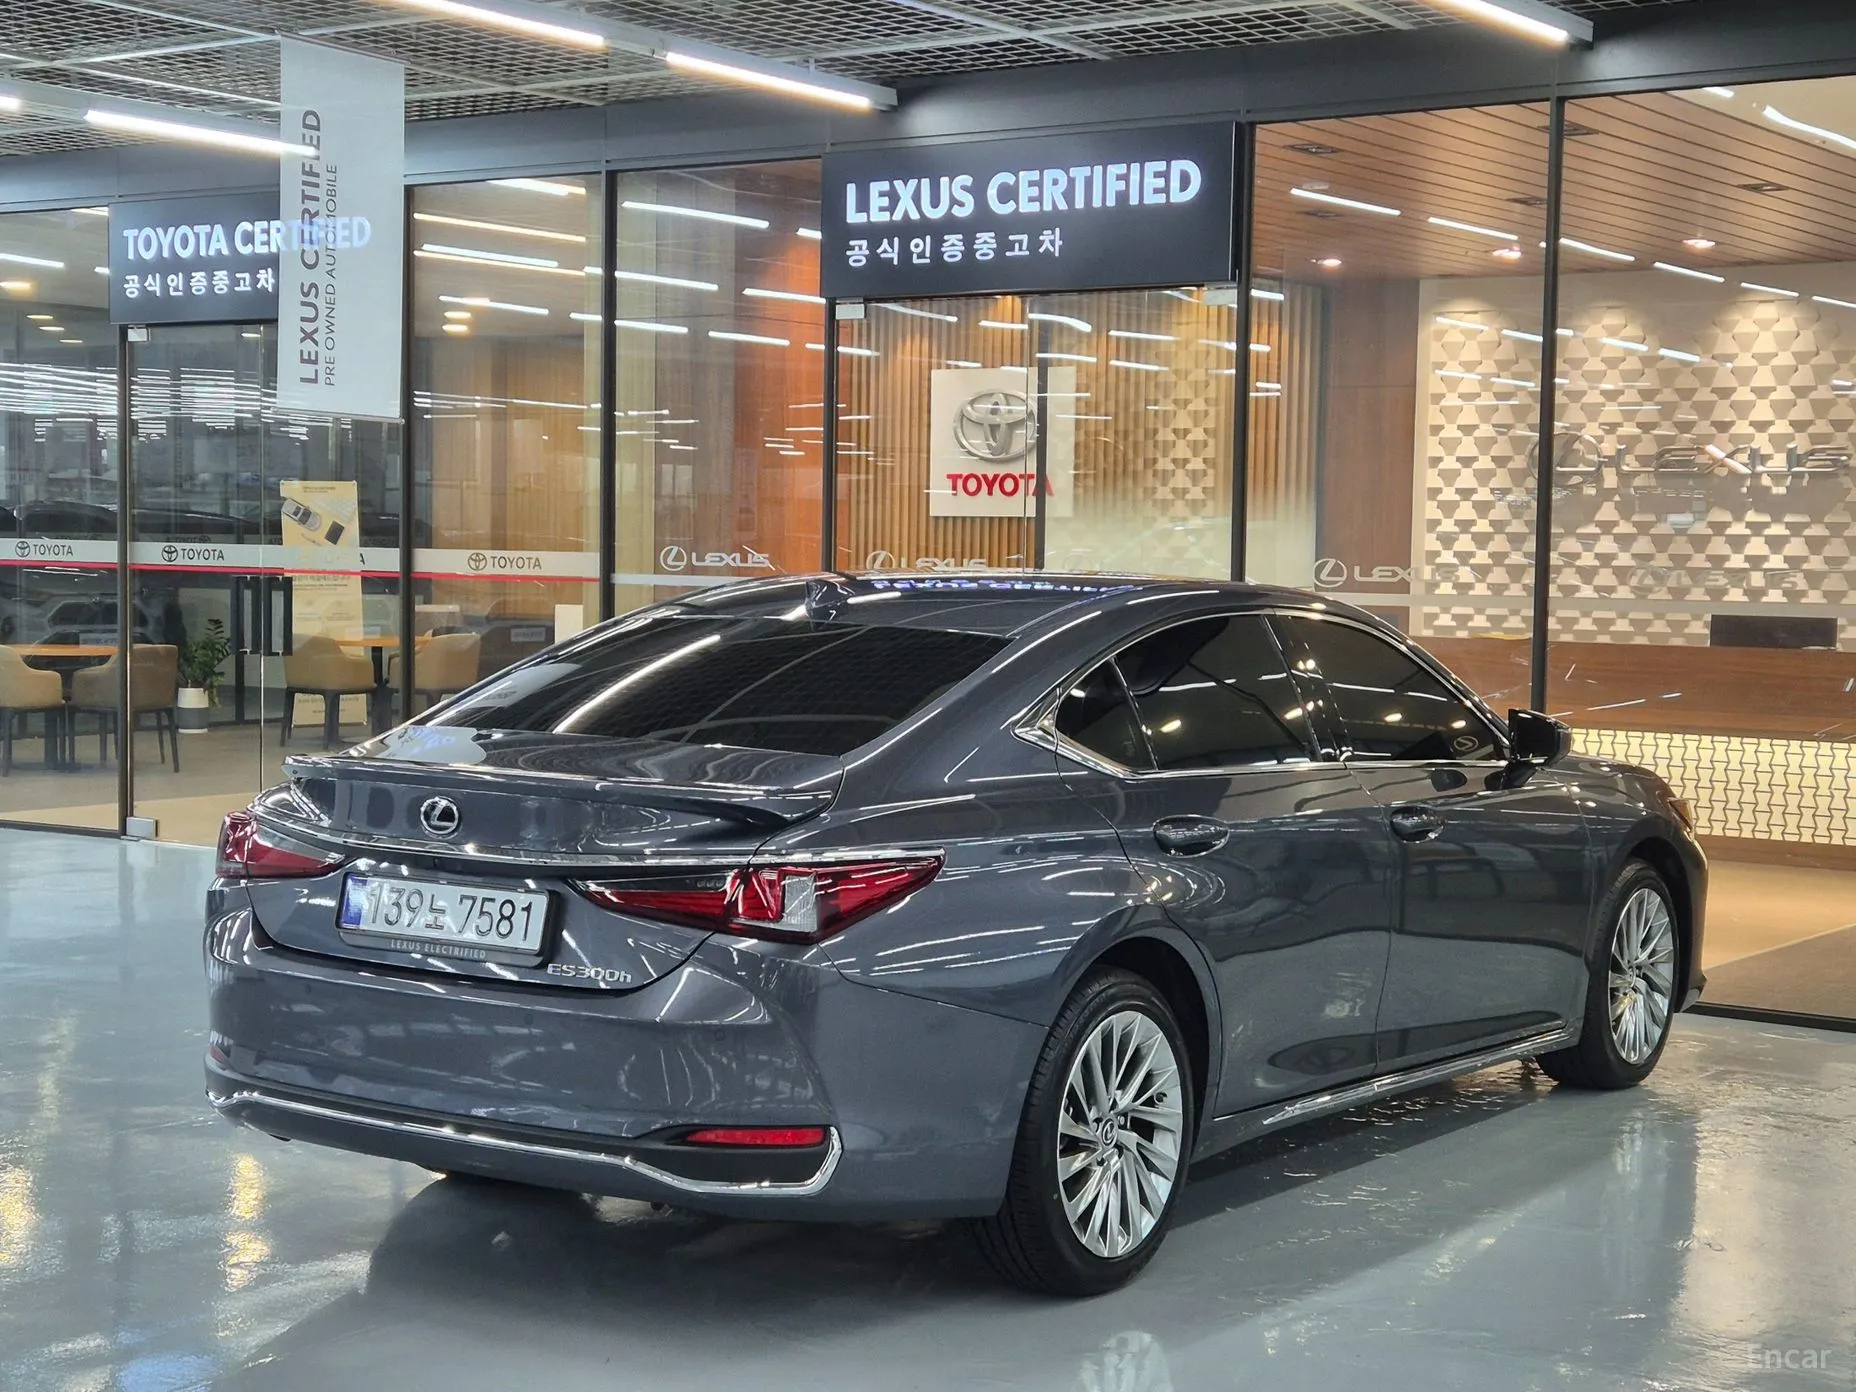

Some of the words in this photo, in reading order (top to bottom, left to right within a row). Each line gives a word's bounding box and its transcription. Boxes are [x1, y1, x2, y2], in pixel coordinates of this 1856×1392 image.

[845, 174, 975, 224] LEXUS
[986, 158, 1202, 215] CERTIFIED
[325, 164, 337, 279] AUTOMOBILE
[122, 223, 229, 261] TOYOTA
[845, 226, 1063, 268] 공식인증중고차
[122, 267, 276, 299] 공식인증중고차
[299, 280, 320, 385] LEXUS
[324, 283, 337, 351] OWNED
[324, 356, 335, 386] PRE
[1615, 443, 1850, 474] LEXUS
[32, 543, 74, 557] TOYOTA
[180, 548, 225, 561] TOYOTA
[490, 555, 542, 570] TOYOTA
[691, 551, 770, 568] LEXUS
[1353, 565, 1461, 583] LEXUS
[367, 881, 446, 931] 139노
[457, 894, 534, 942] 7581
[390, 939, 421, 951] LEXUS
[424, 942, 487, 959] ELECTRIFIED
[546, 963, 632, 984] ES300h
